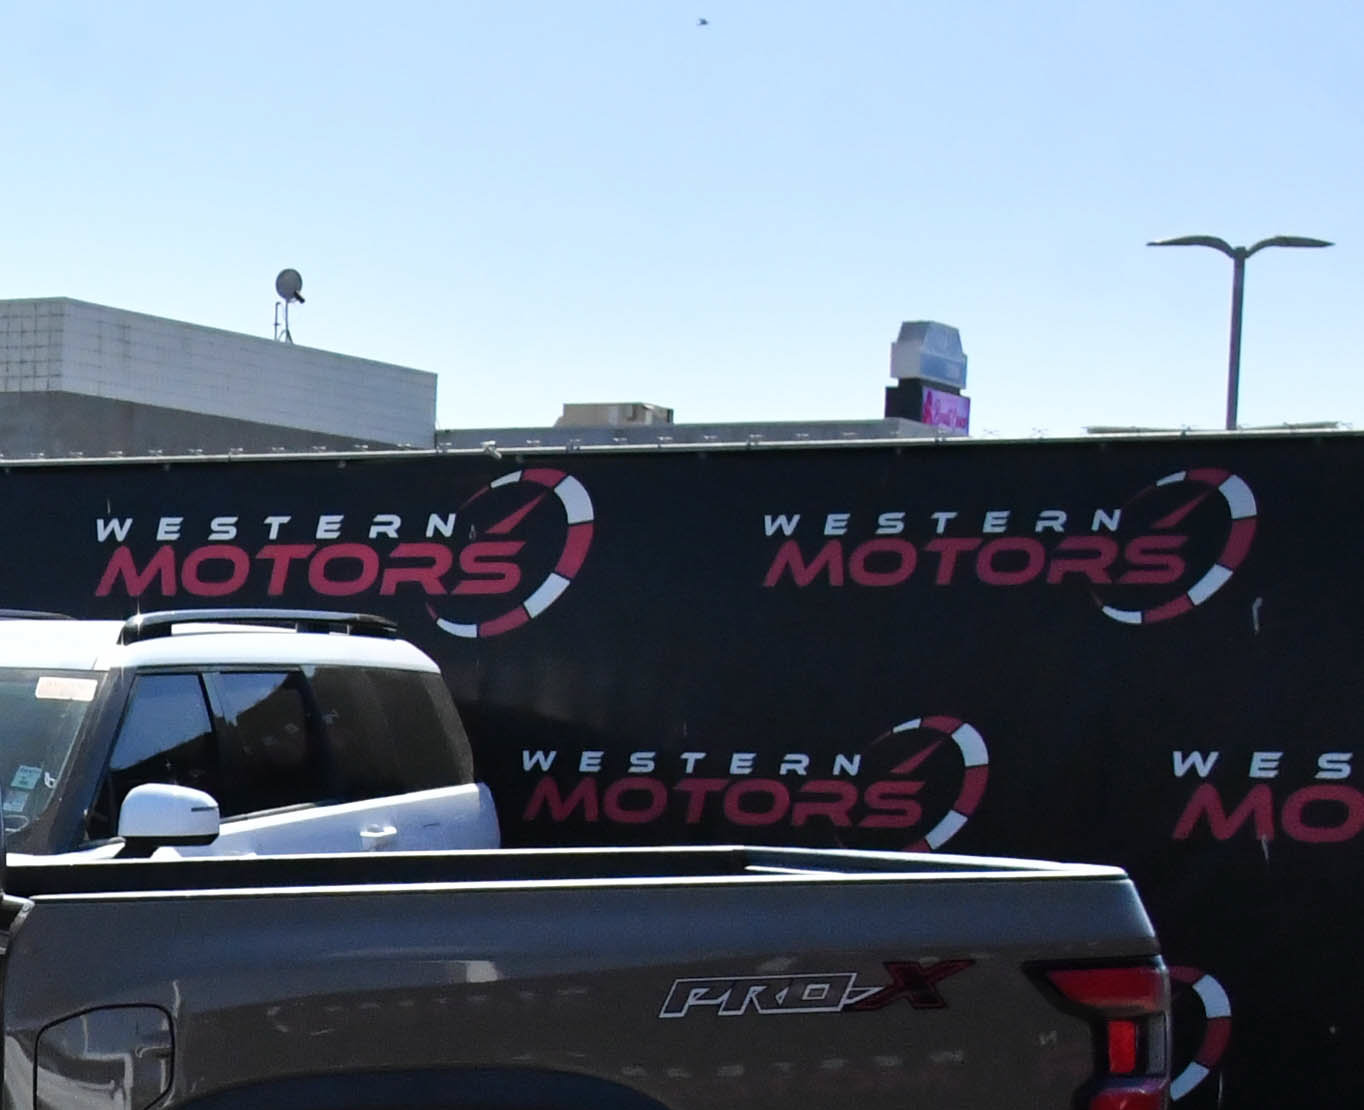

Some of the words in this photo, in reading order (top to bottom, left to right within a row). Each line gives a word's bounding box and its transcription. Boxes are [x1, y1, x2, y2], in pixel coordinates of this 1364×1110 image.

[96, 513, 457, 542] WESTERN
[764, 509, 1122, 537] WESTERN
[95, 541, 525, 597] MOTORS
[765, 535, 1190, 588] MOTORS
[522, 749, 862, 777] WESTERN
[524, 777, 926, 828] MOTORS
